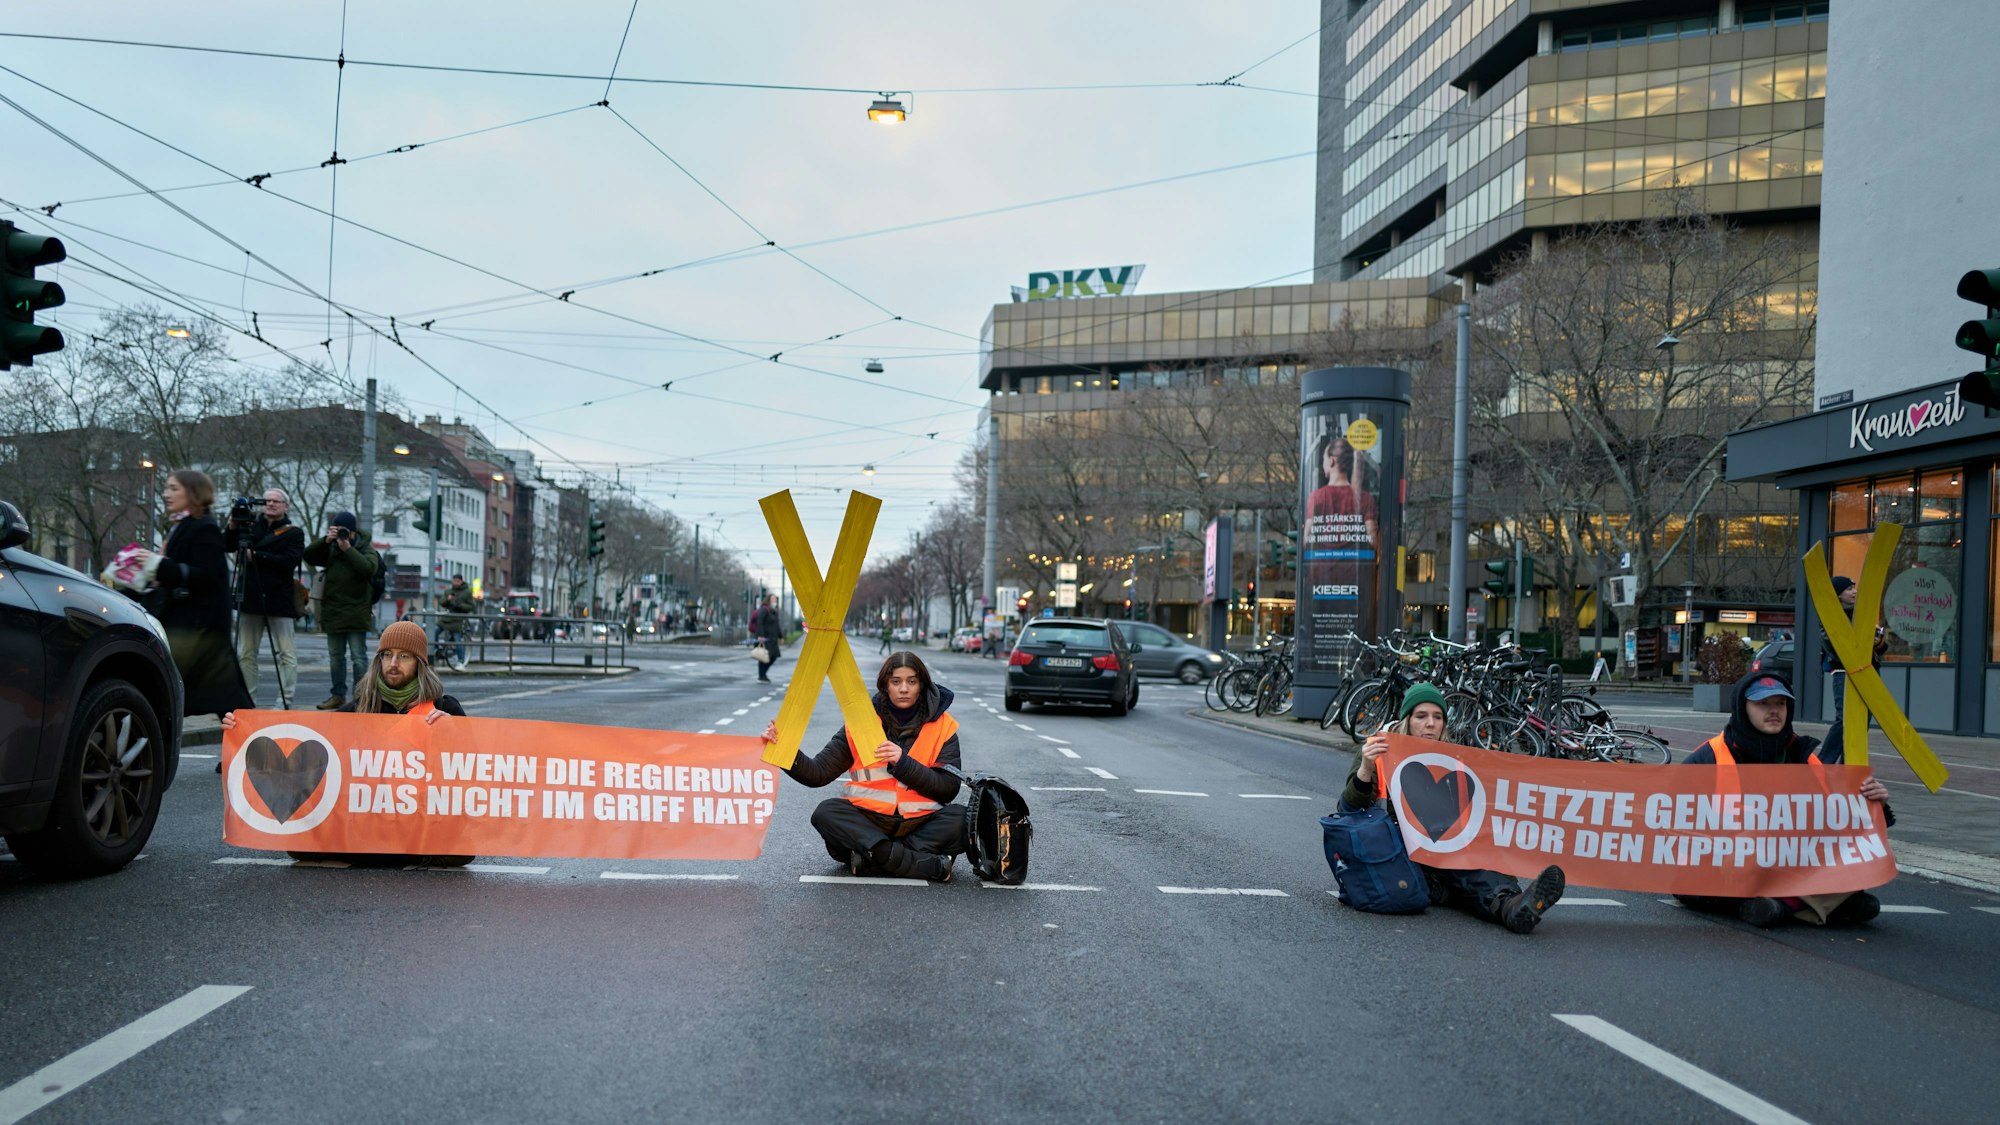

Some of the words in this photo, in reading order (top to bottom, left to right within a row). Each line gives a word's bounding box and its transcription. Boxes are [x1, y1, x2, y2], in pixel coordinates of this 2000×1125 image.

[1028, 266, 1133, 300] DKV
[1311, 524, 1366, 534] ENTSCHEIDUNG
[1313, 515, 1324, 523] DIE
[1325, 513, 1363, 523] STÄRKSTE
[1317, 534, 1338, 542] IHREN
[1313, 585, 1358, 595] KIESER
[350, 749, 433, 782] WAS,
[441, 752, 537, 784] WENN
[546, 758, 596, 787] DIE
[604, 761, 774, 795] REGIERUNG
[349, 782, 418, 814] DAS
[427, 786, 534, 819] NICHT
[543, 790, 584, 820] IM
[594, 793, 686, 823] GRIFF
[693, 797, 774, 826] HAT?
[1493, 778, 1634, 828] LETZTE
[1645, 792, 1874, 831] GENERATION
[1491, 816, 1566, 855] VOR
[1574, 830, 1645, 863] DEN
[1652, 833, 1888, 869] KIPPPUNKTEN
